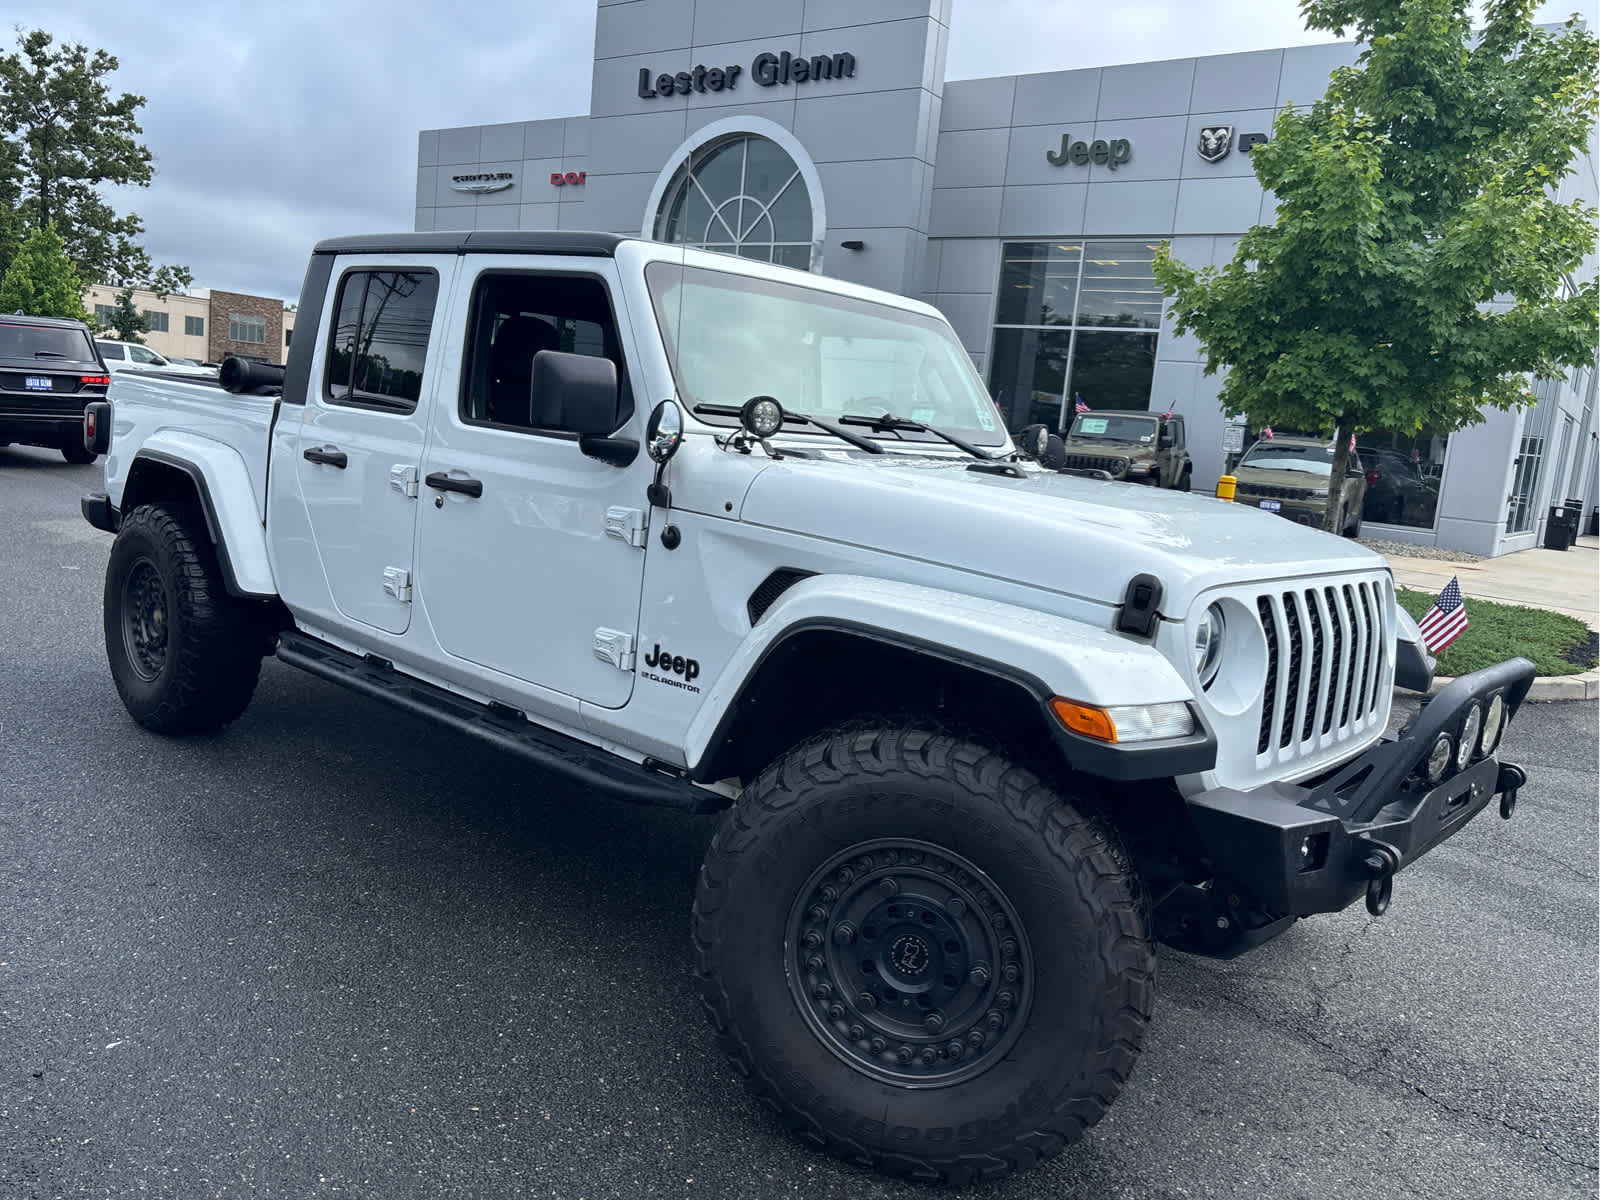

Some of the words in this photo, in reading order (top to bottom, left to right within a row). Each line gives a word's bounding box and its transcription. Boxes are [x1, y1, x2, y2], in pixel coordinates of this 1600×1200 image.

[638, 65, 742, 99] Lester
[751, 51, 856, 87] Glenn
[1046, 133, 1130, 171] Jeep
[645, 643, 700, 683] Jeep
[650, 673, 701, 694] GLADIATOR
